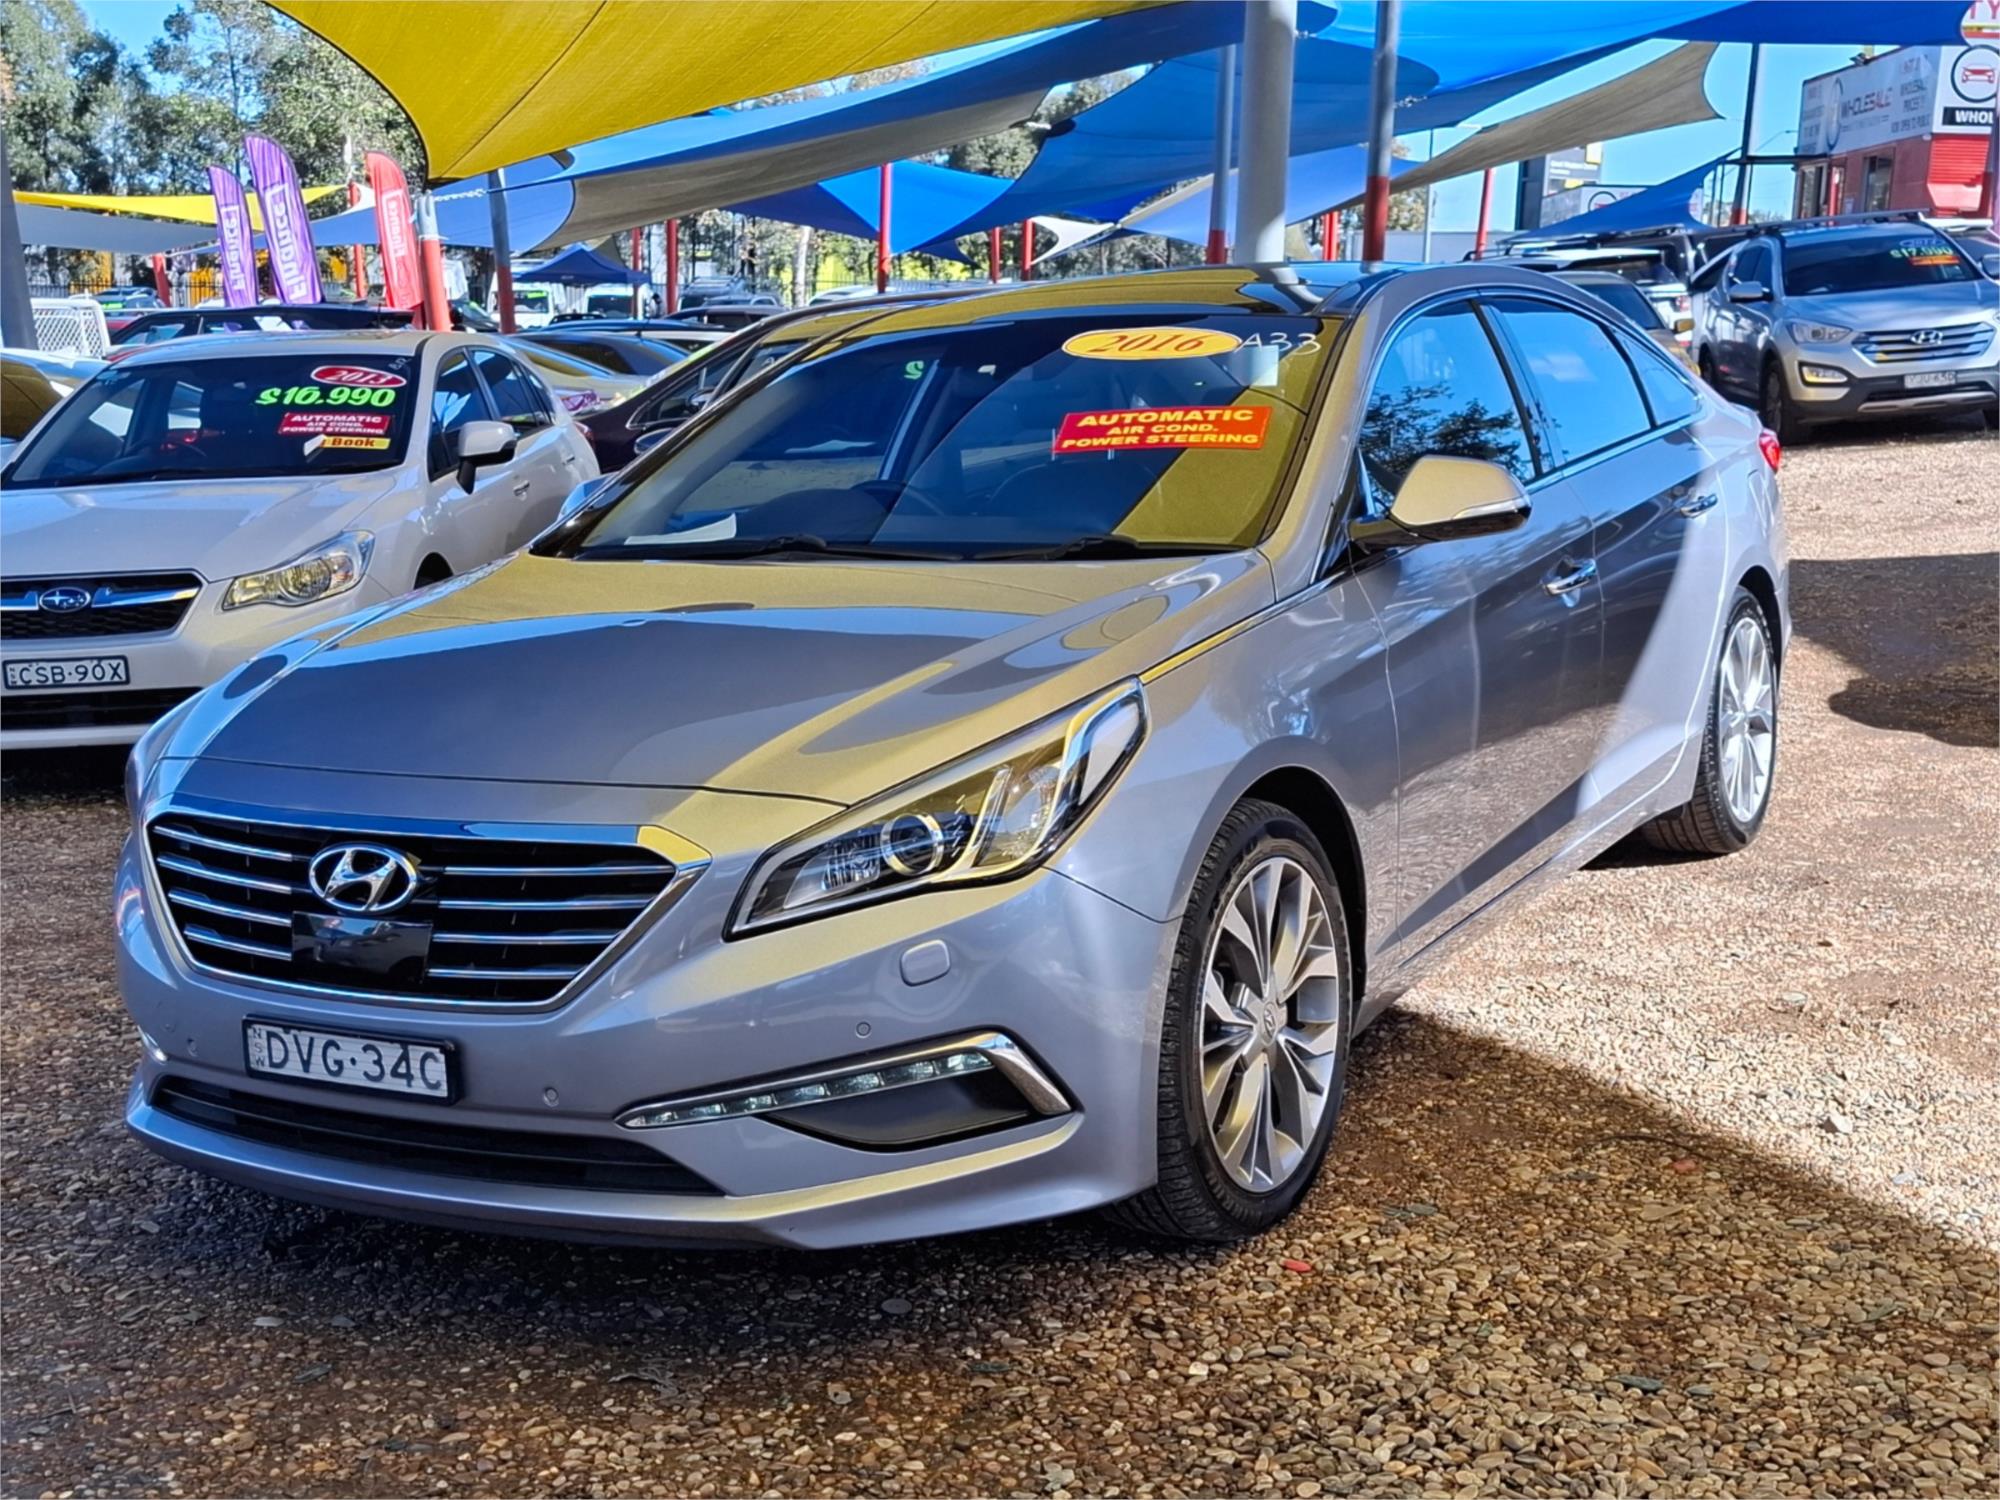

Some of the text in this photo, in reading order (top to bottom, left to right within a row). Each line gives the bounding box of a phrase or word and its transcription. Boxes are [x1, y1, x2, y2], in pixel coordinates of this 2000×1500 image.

[1086, 333, 1213, 354] 2016
[1234, 331, 1321, 355] A33
[325, 370, 392, 385] 2013
[291, 415, 382, 423] AUTOMATIC
[1077, 409, 1254, 427] AUTOMATIC
[1107, 423, 1219, 436] AIR COND.
[331, 437, 375, 447] Book
[1061, 433, 1259, 449] POWER STEERING
